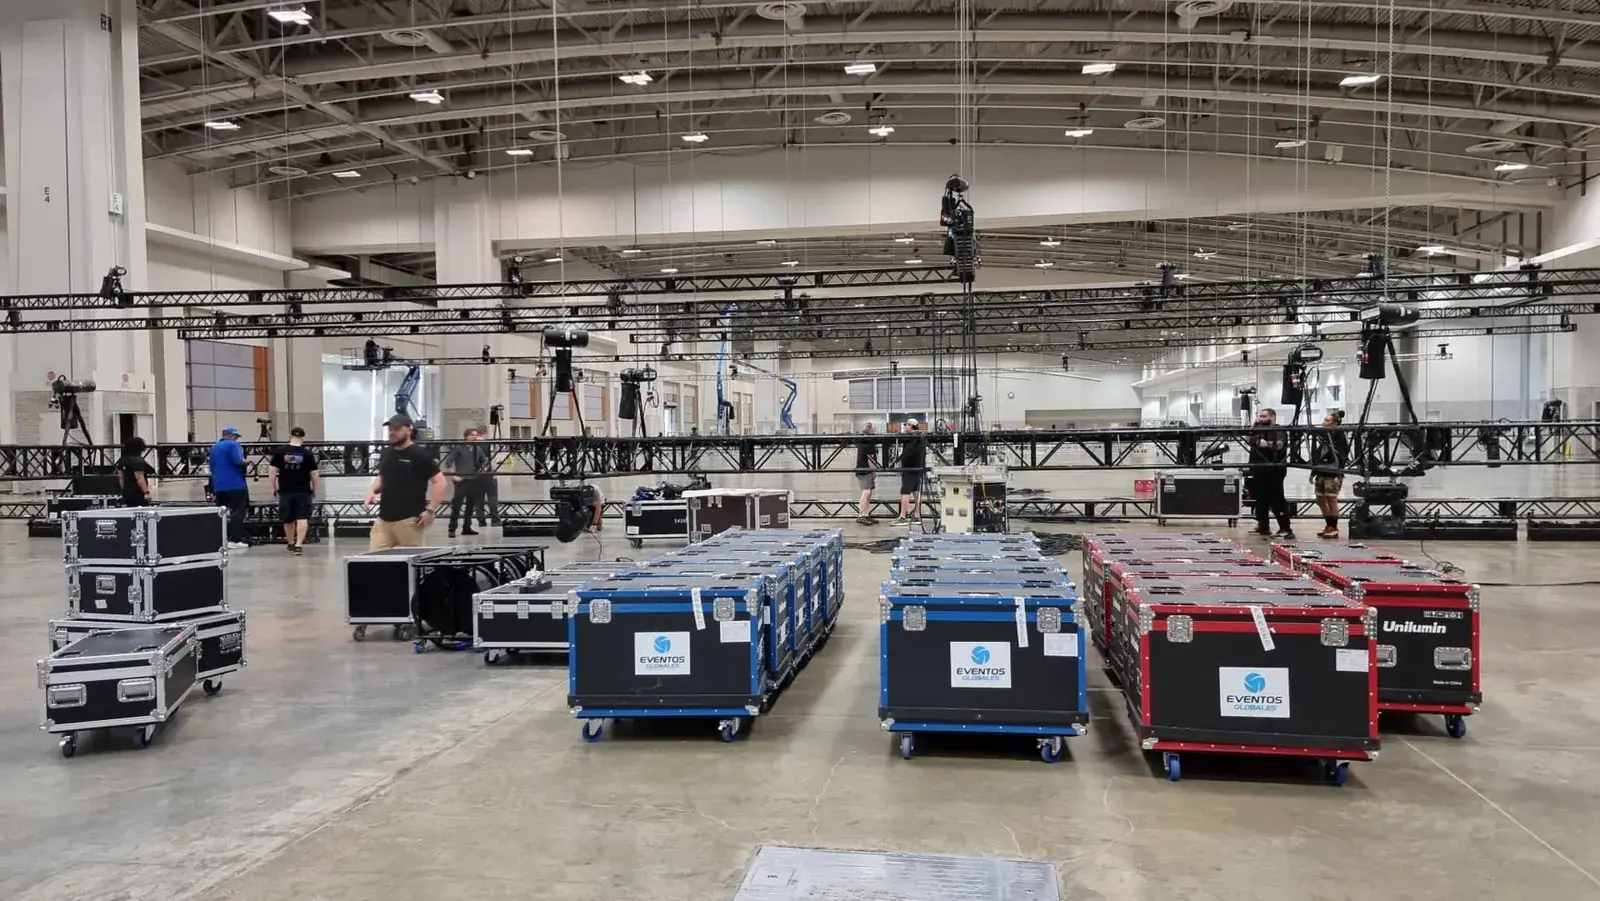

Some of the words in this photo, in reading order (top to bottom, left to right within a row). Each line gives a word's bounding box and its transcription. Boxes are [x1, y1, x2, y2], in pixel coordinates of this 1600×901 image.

[1382, 620, 1447, 634] Unilumin
[640, 656, 686, 664] EVENTOS
[956, 667, 1006, 676] EVENTOS
[1226, 695, 1283, 704] EVENTOS
[1234, 704, 1277, 712] GLOBALES
